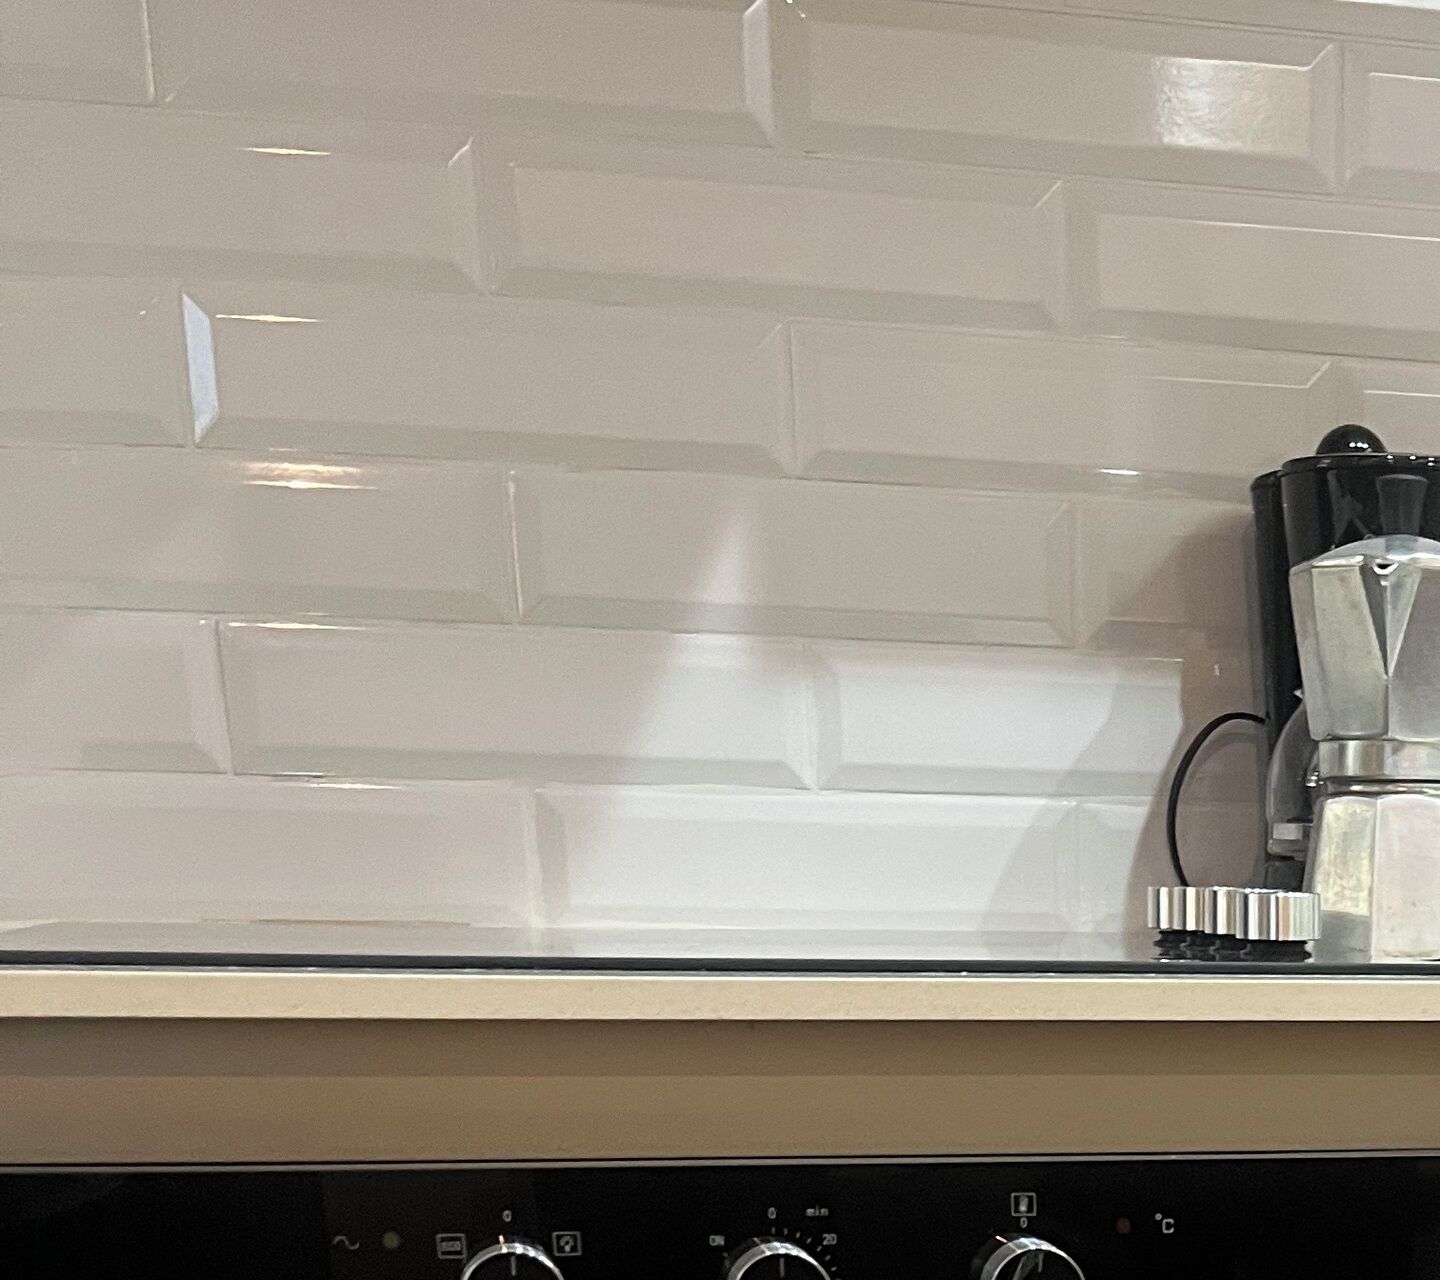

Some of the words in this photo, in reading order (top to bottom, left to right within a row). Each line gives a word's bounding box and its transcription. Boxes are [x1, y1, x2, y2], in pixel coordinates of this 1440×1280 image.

[768, 1207, 776, 1220] 0
[805, 1205, 829, 1217] min
[1020, 1217, 1027, 1229] 0
[1154, 1212, 1175, 1234] °C
[823, 1233, 838, 1246] 20
